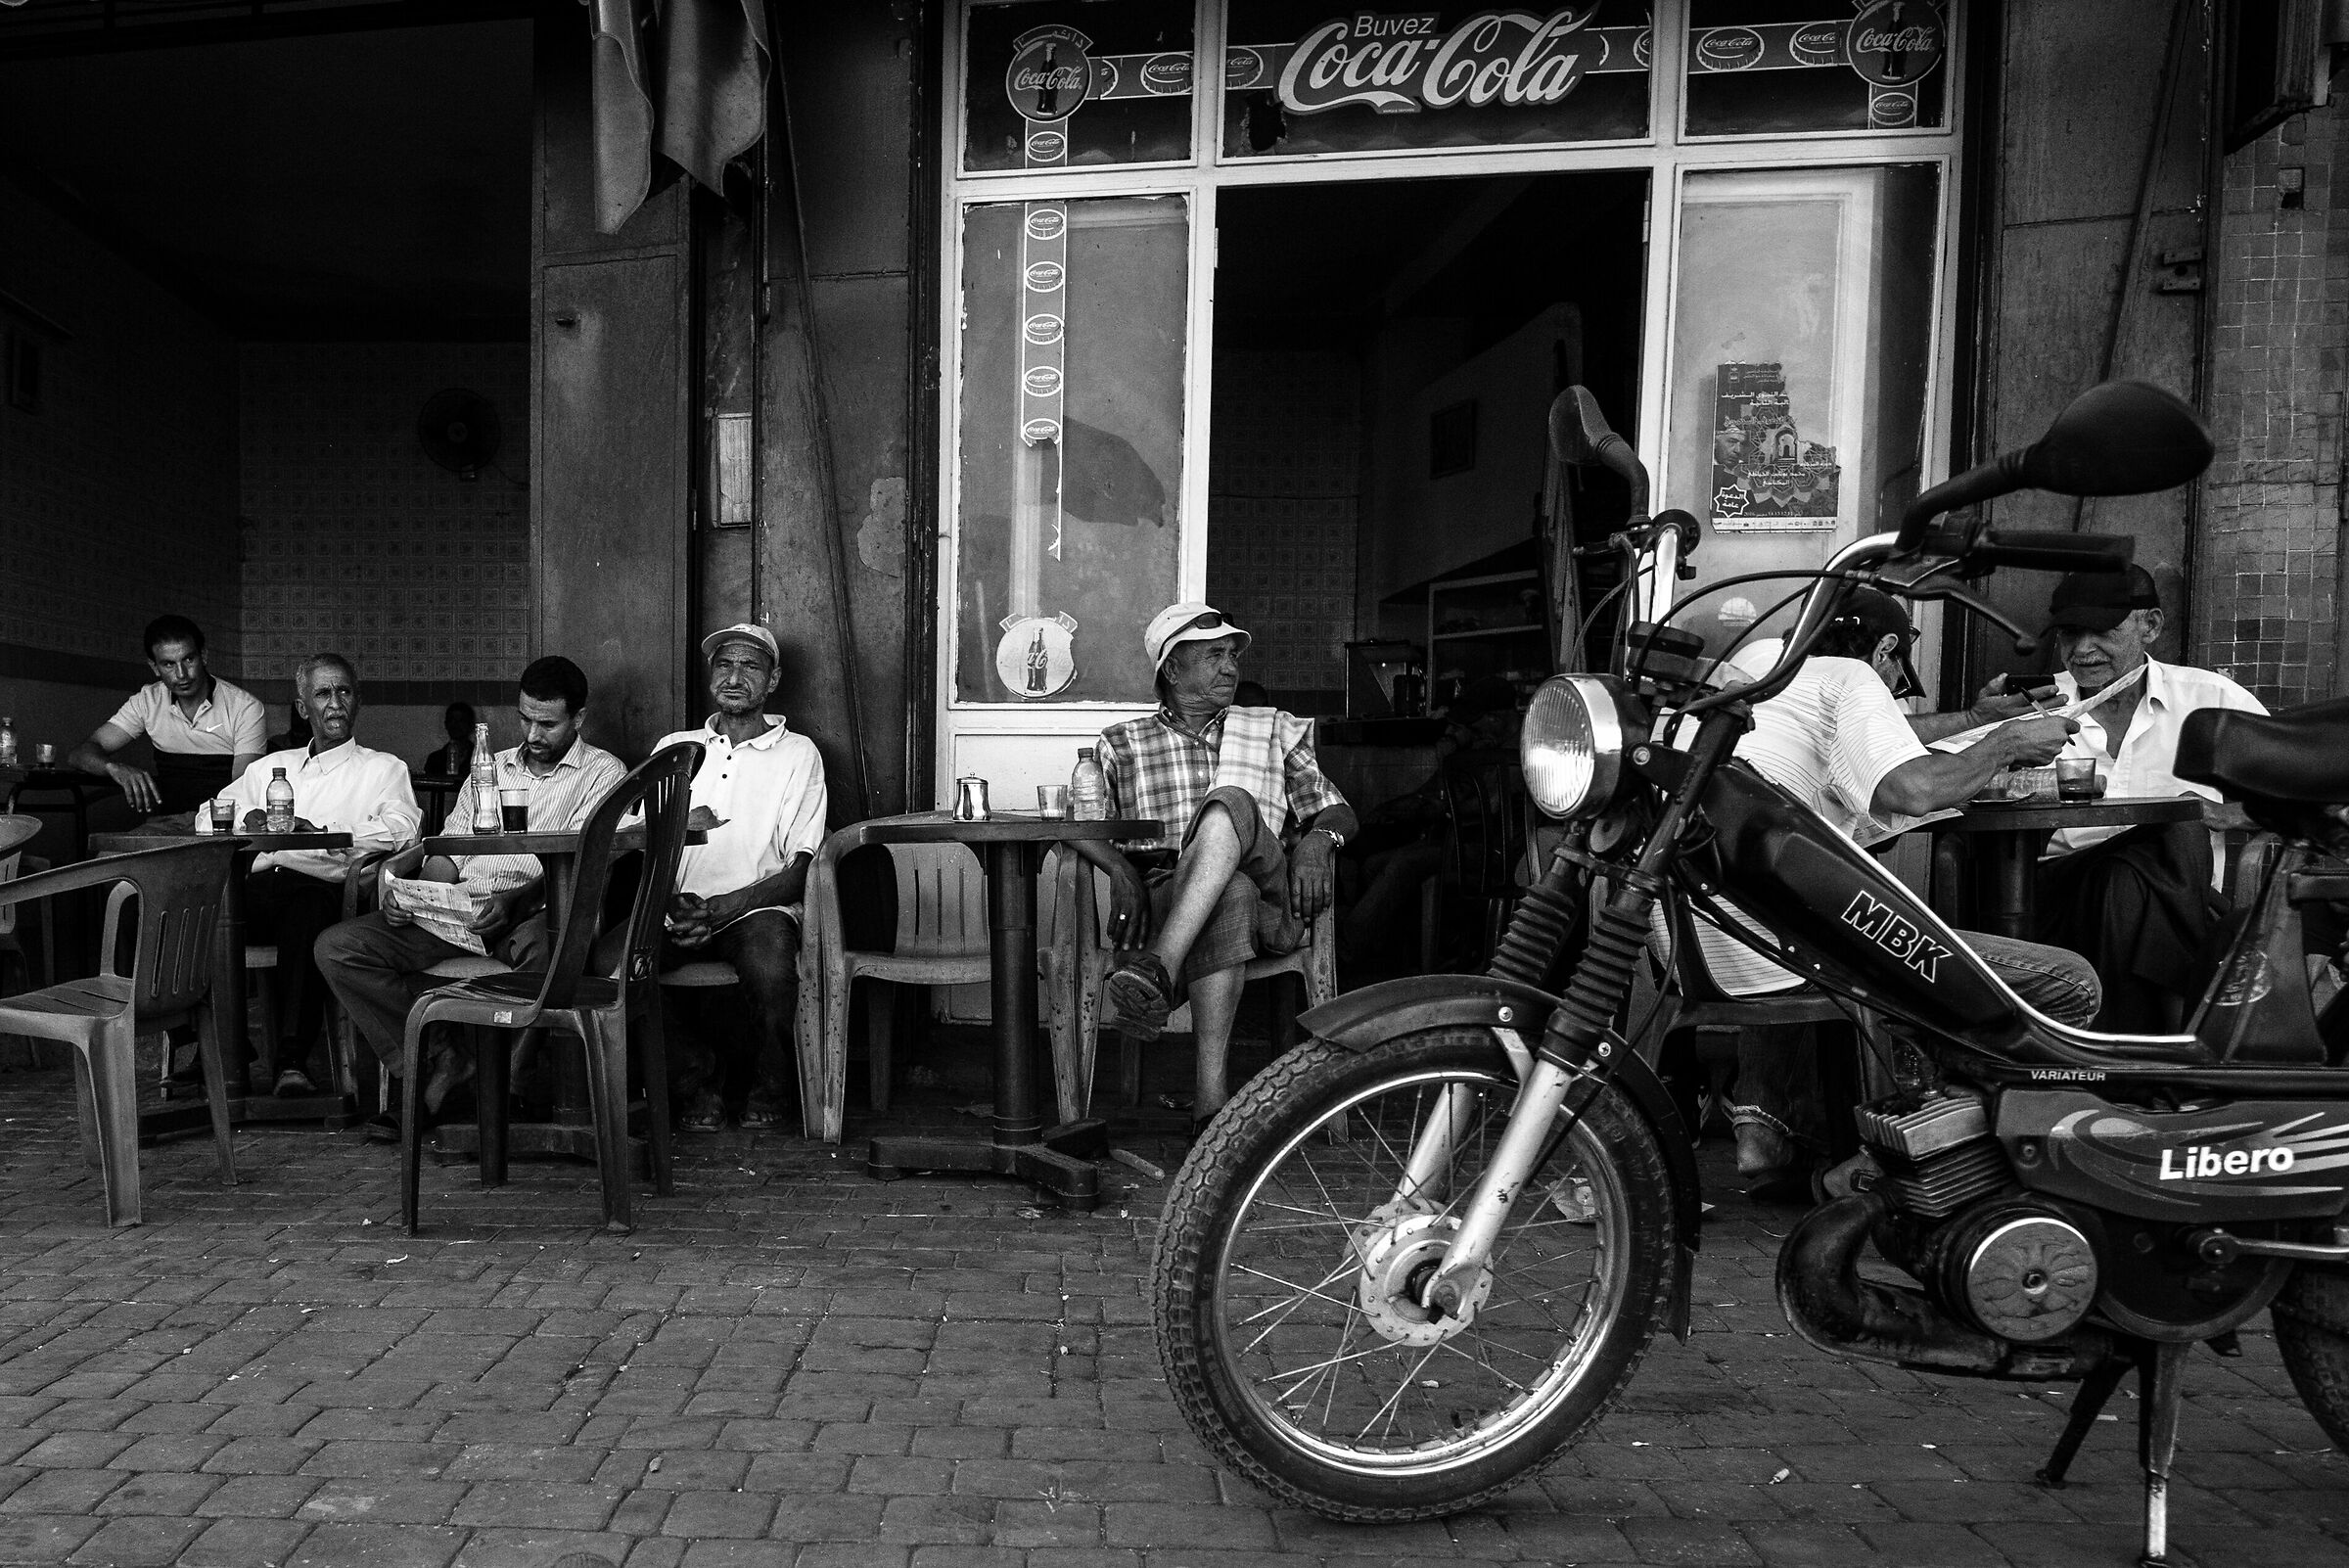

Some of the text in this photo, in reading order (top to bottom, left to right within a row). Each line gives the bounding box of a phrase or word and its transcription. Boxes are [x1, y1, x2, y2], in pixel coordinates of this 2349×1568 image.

[1354, 15, 1435, 38] Buvez
[1704, 37, 1755, 48] Coca-Cola
[1856, 26, 1937, 53] Coca-Cola
[1278, 10, 1593, 112] Coca-Cola
[1014, 66, 1083, 92] Coca-Cola
[1721, 490, 1744, 500] الدعوة
[1722, 499, 1739, 509] عامة
[1840, 889, 1954, 984] MBK
[2031, 1069, 2106, 1082] VARIATEUR
[2159, 1145, 2295, 1181] Libero
